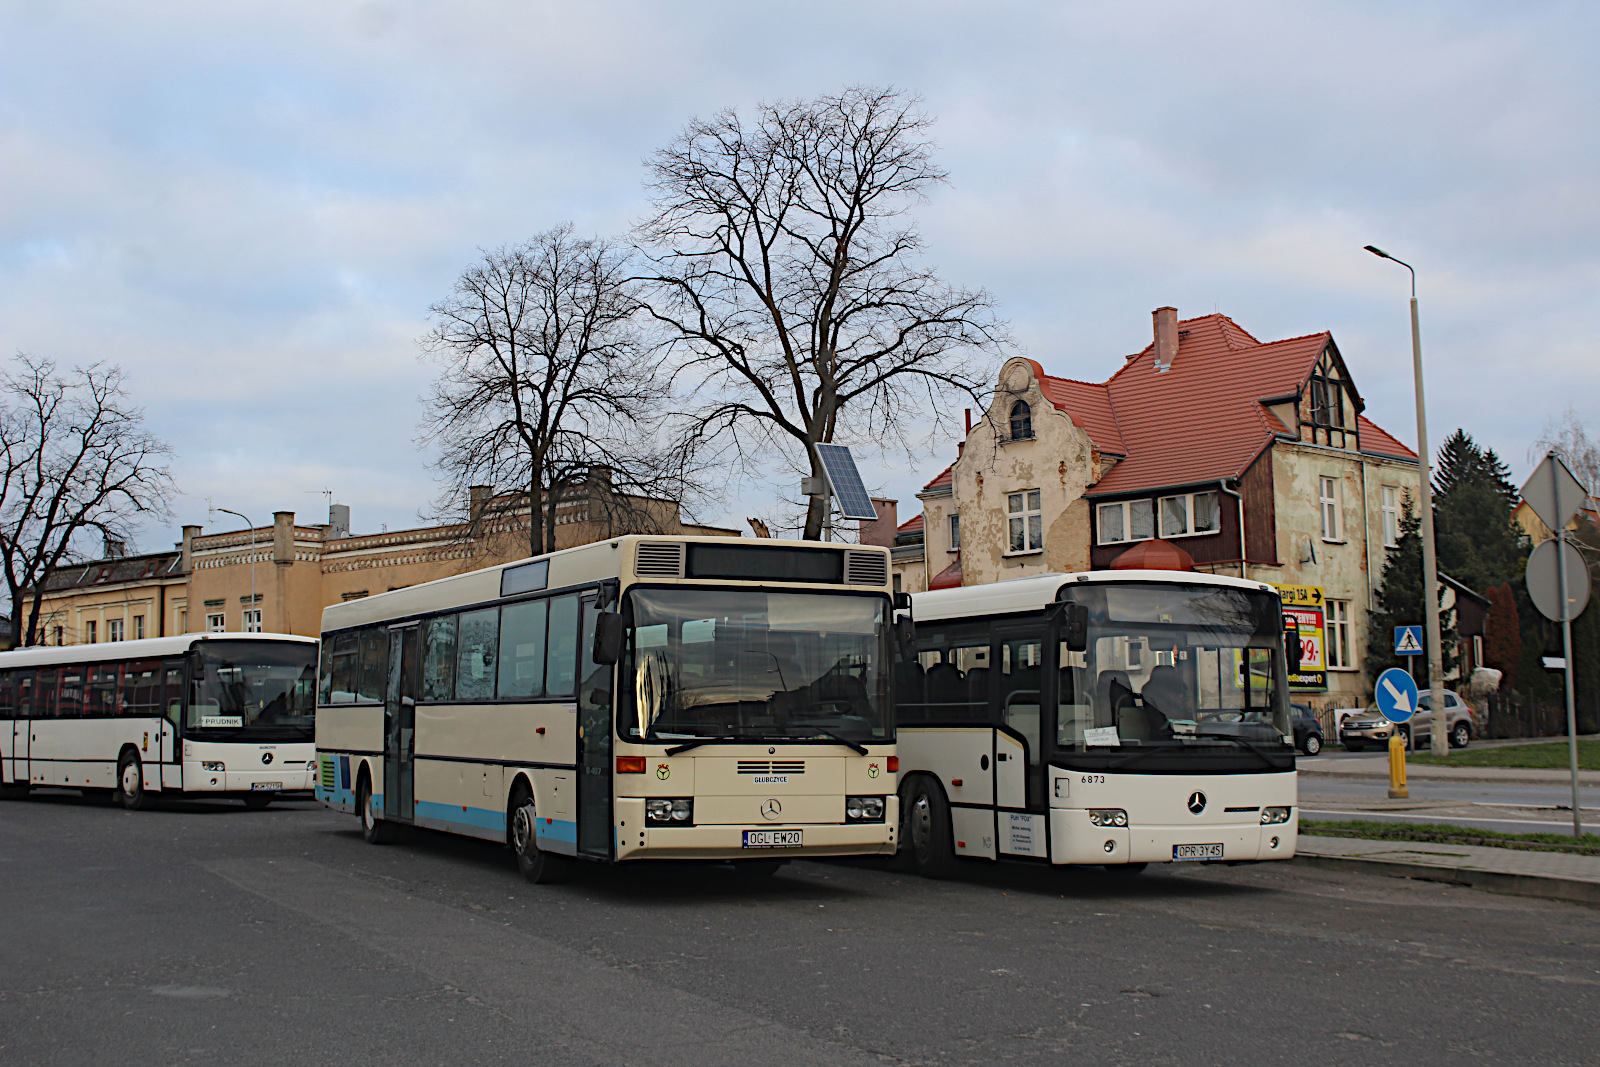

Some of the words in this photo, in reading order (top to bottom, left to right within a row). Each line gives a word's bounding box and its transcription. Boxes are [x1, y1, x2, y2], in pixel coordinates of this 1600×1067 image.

[1297, 588, 1308, 601] 15A
[1081, 775, 1105, 784] 6873
[750, 832, 770, 844] OGL
[773, 832, 800, 844] EW20
[1180, 846, 1196, 857] OPR
[1199, 845, 1221, 856] 3Y45
